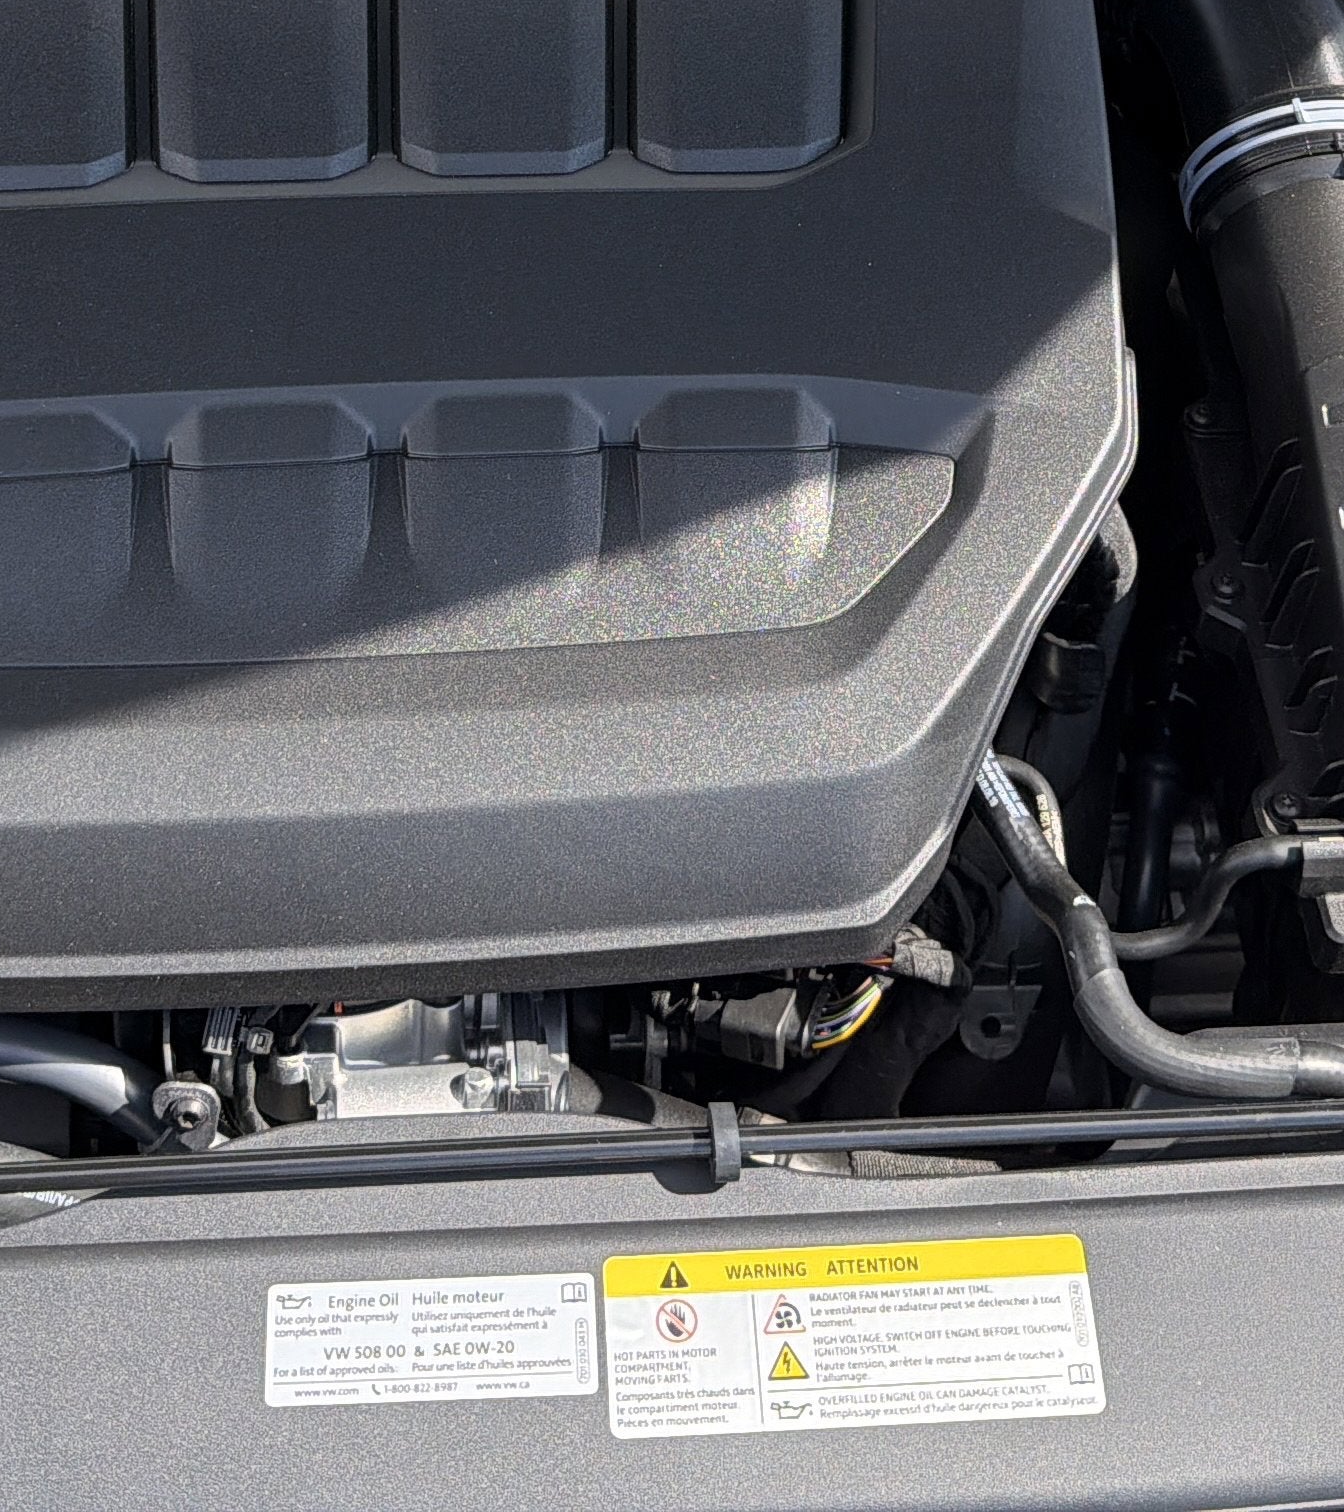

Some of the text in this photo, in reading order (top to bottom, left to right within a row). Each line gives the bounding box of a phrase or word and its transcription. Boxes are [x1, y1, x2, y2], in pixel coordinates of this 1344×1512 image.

[725, 1256, 919, 1280] WARNING ATTENTION
[412, 1290, 505, 1306] Huile moteur
[809, 1291, 857, 1302] RADIATOR
[858, 1290, 879, 1300] FAN
[881, 1289, 901, 1299] MAY
[902, 1288, 931, 1298] START
[933, 1287, 945, 1297] AT
[947, 1286, 967, 1296] ANY
[327, 1293, 399, 1312] Engine Oil
[810, 1306, 822, 1317] Le
[824, 1303, 877, 1315] ventilateur
[879, 1303, 891, 1313] de
[893, 1300, 938, 1311] radiateur
[940, 1299, 963, 1311] peut
[965, 1300, 976, 1308] se
[1041, 1294, 1061, 1304] tout
[274, 1311, 399, 1326] Use only oil that expressly
[411, 1309, 448, 1322] Utilisez
[450, 1308, 510, 1322] uniquement
[512, 1307, 524, 1317] de
[274, 1326, 342, 1339] complies with
[411, 1323, 428, 1337] qui
[430, 1322, 469, 1334] satisfait
[813, 1334, 837, 1345] HIGH
[885, 1331, 922, 1342] SWITCH
[924, 1329, 943, 1340] OFF
[945, 1328, 980, 1339] ENGINE
[983, 1326, 1020, 1337] BEFORE
[323, 1341, 516, 1360] VW 508 00 & SAE 0W-20
[614, 1347, 717, 1361] HOT PARTS IN MOTOR
[815, 1345, 858, 1356] IGNITION
[412, 1362, 436, 1373] Pour
[437, 1362, 455, 1372] une
[457, 1360, 477, 1372] liste
[816, 1361, 844, 1371] Haute
[925, 1356, 934, 1366] le
[937, 1355, 972, 1365] moteur
[1004, 1351, 1017, 1361] de
[273, 1367, 289, 1378] For
[291, 1368, 297, 1377] a
[298, 1365, 315, 1377] list
[316, 1364, 327, 1376] of
[328, 1363, 376, 1377] approved
[615, 1375, 655, 1385] MOVING
[616, 1386, 755, 1403] Composants chauds dans
[819, 1393, 878, 1406] OVERFILLED
[880, 1391, 917, 1402] ENGINE
[918, 1389, 935, 1400] OIL
[937, 1389, 957, 1399] CAN
[958, 1387, 1000, 1398] DAMAGE
[617, 1402, 699, 1416] le compartiment
[651, 1416, 664, 1425] en
